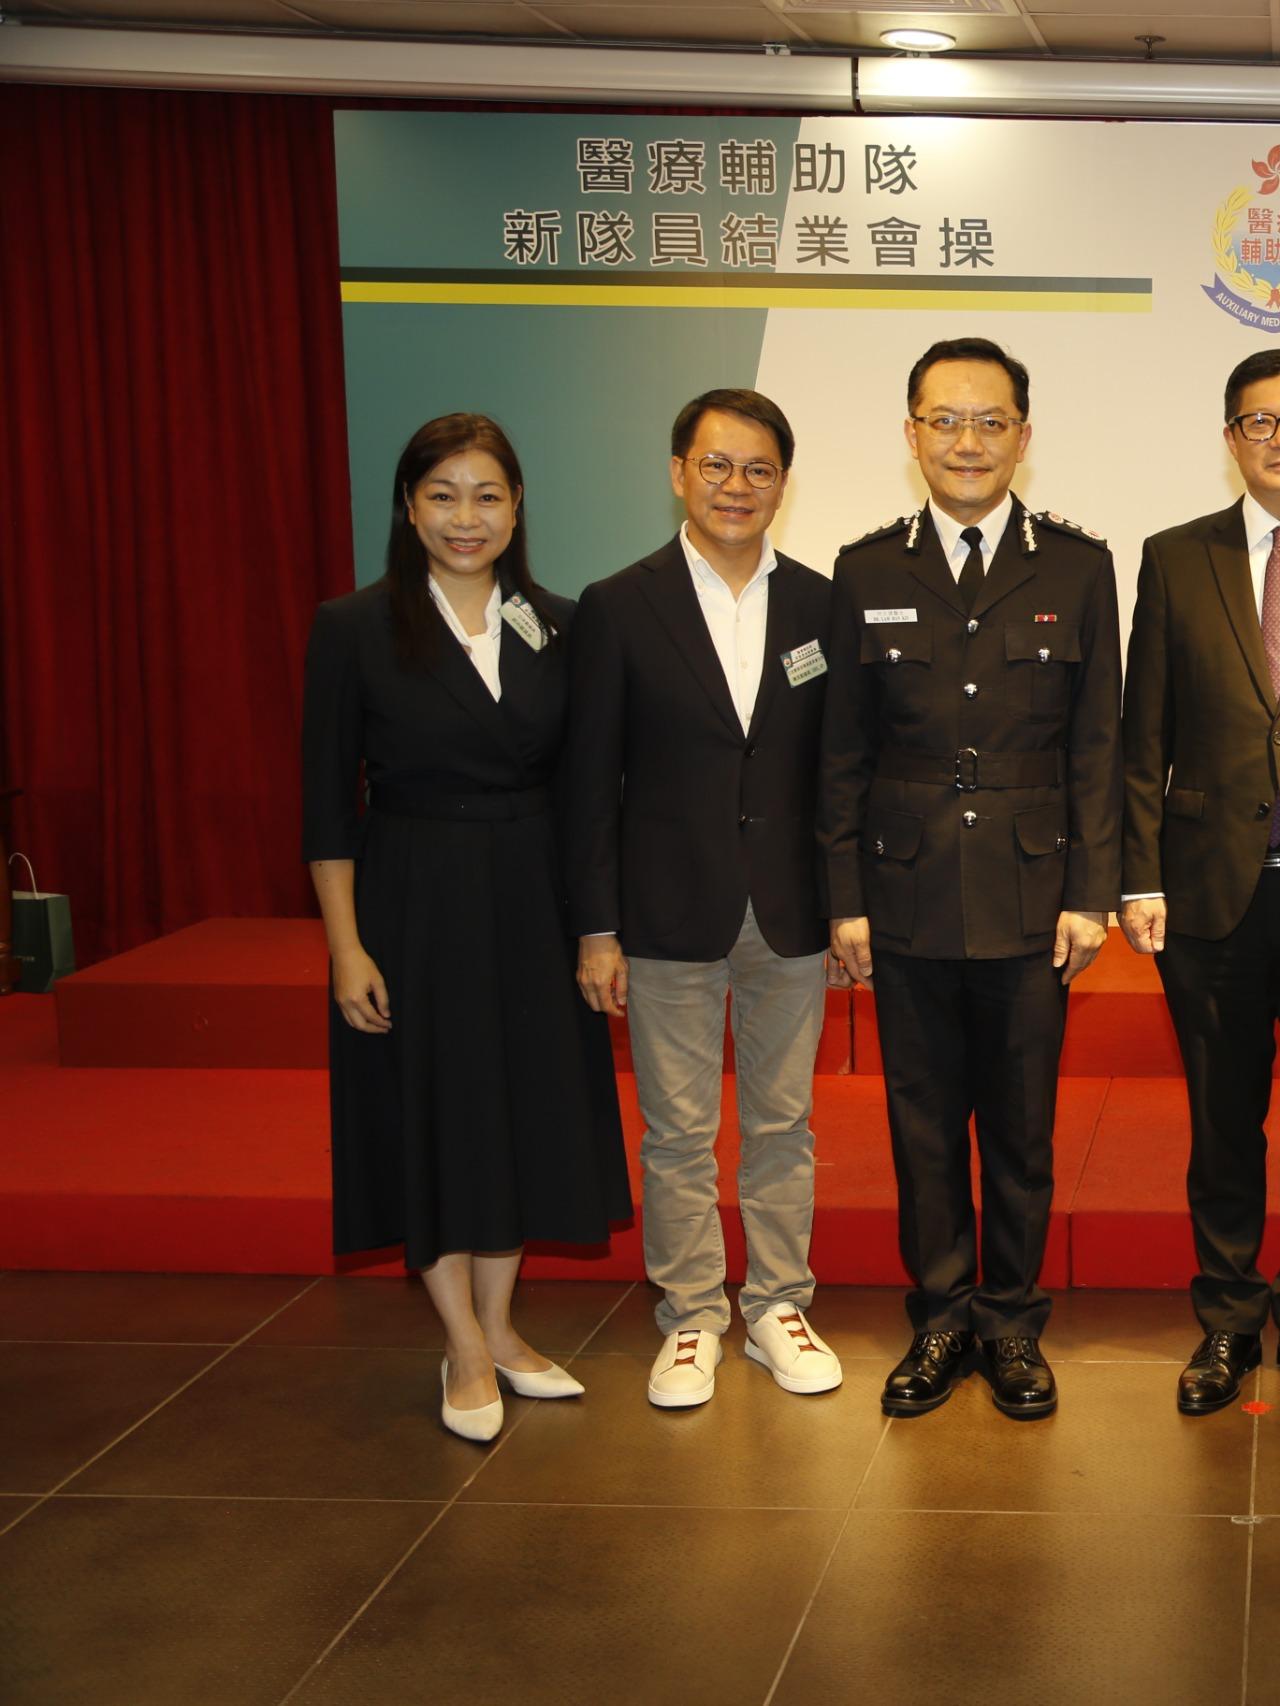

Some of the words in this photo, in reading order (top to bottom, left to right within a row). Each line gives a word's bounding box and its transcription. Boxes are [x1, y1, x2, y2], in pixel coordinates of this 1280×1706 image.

[576, 137, 919, 196] 醫療輔助隊
[502, 208, 996, 269] 新隊員結業會操
[1216, 292, 1260, 324] AUXILIARY
